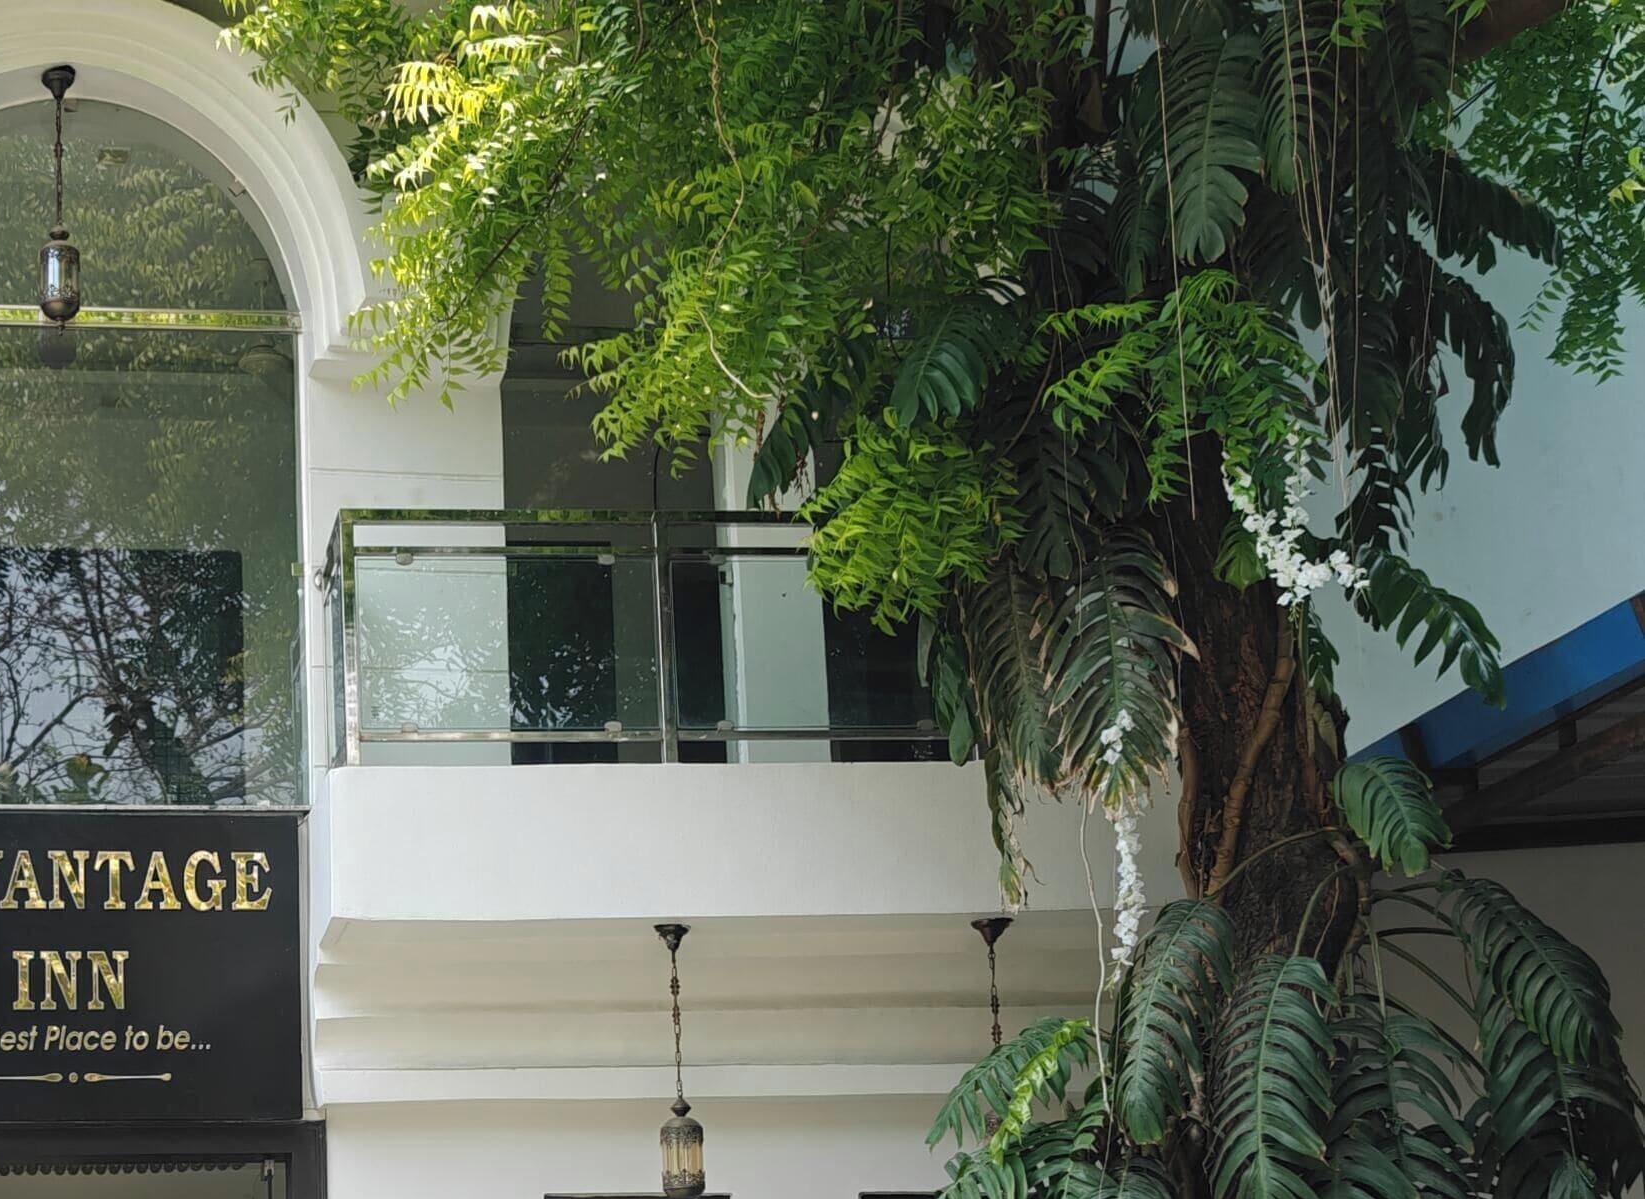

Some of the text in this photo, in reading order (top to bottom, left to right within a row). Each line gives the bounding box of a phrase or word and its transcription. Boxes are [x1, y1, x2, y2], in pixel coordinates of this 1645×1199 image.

[12, 950, 130, 1011] INN
[43, 1024, 117, 1051] Place
[124, 1024, 150, 1051] to
[156, 1024, 212, 1051] be...
